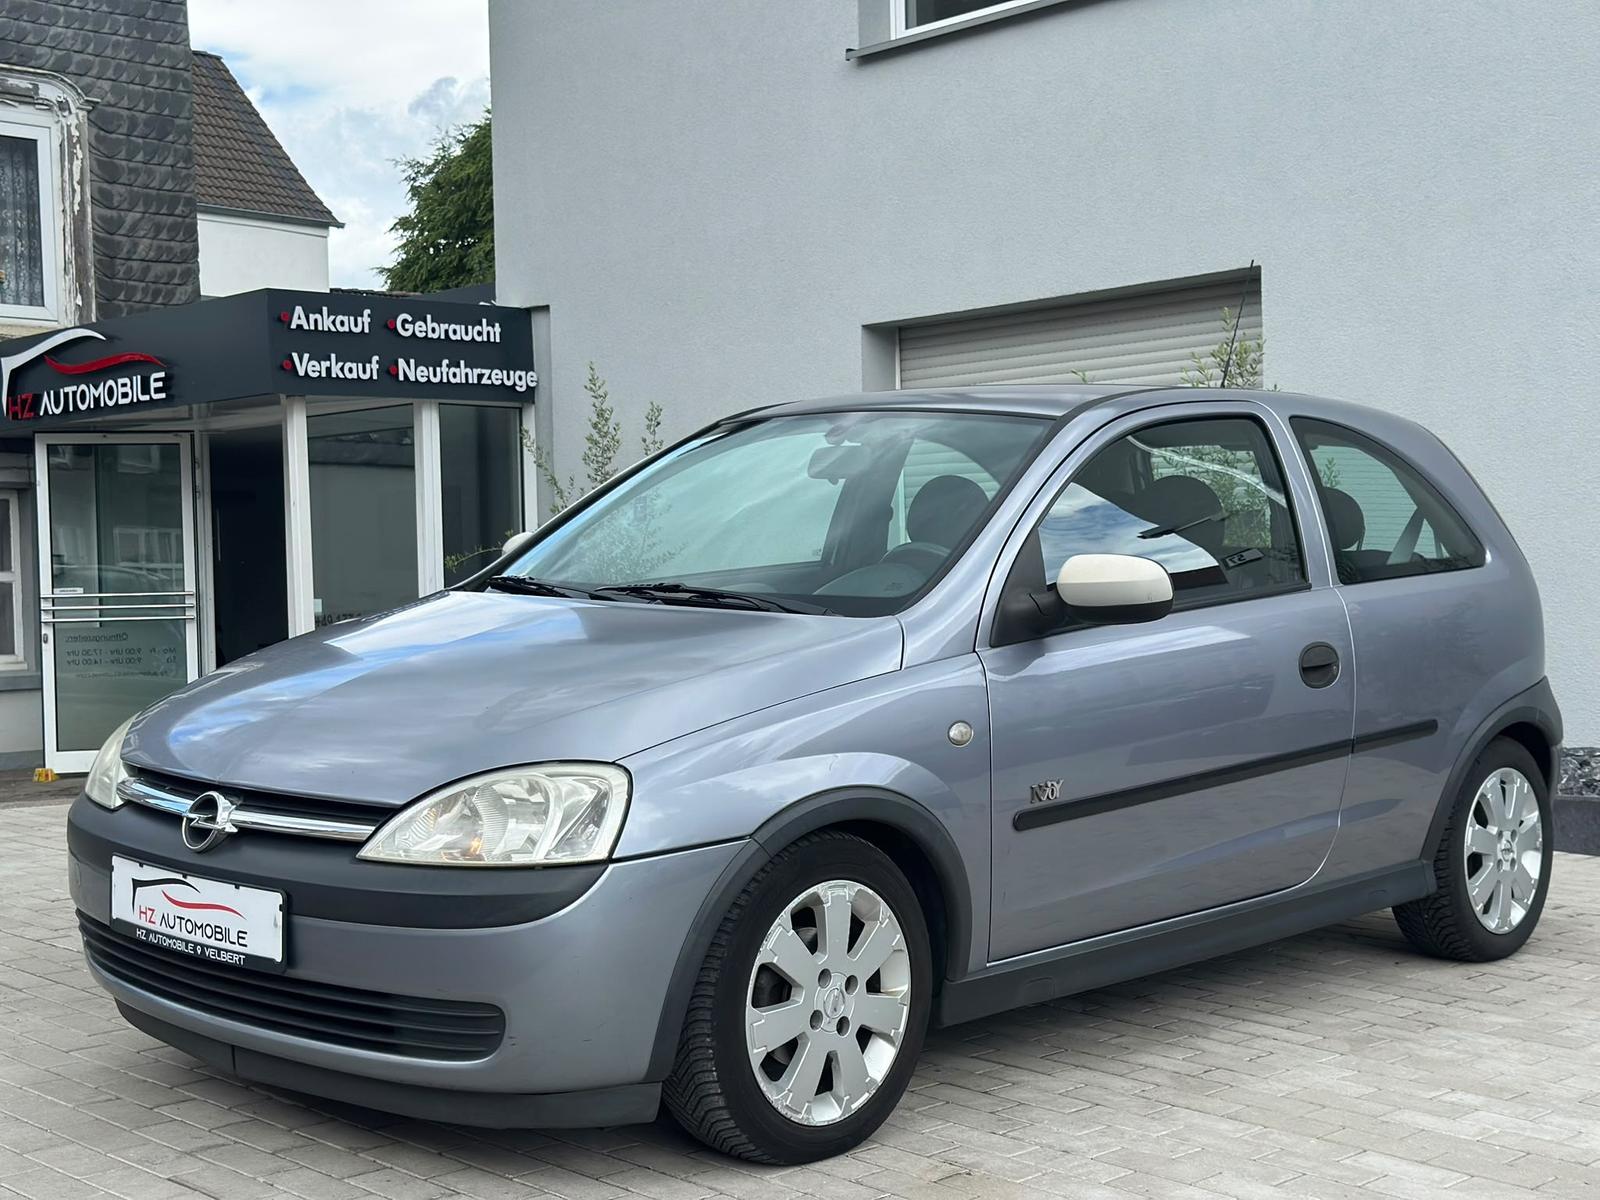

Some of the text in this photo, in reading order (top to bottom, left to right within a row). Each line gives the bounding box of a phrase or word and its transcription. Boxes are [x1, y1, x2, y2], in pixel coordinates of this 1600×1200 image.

[290, 306, 501, 343] Ankauf Gebraucht
[291, 352, 538, 392] Verkauf Neufahrzeuge
[8, 371, 166, 420] HZ AUTOMOBILE
[138, 905, 248, 947] HZ AUTOMOBILE
[136, 928, 246, 966] HZ AUTOMOBILE VELBERT
